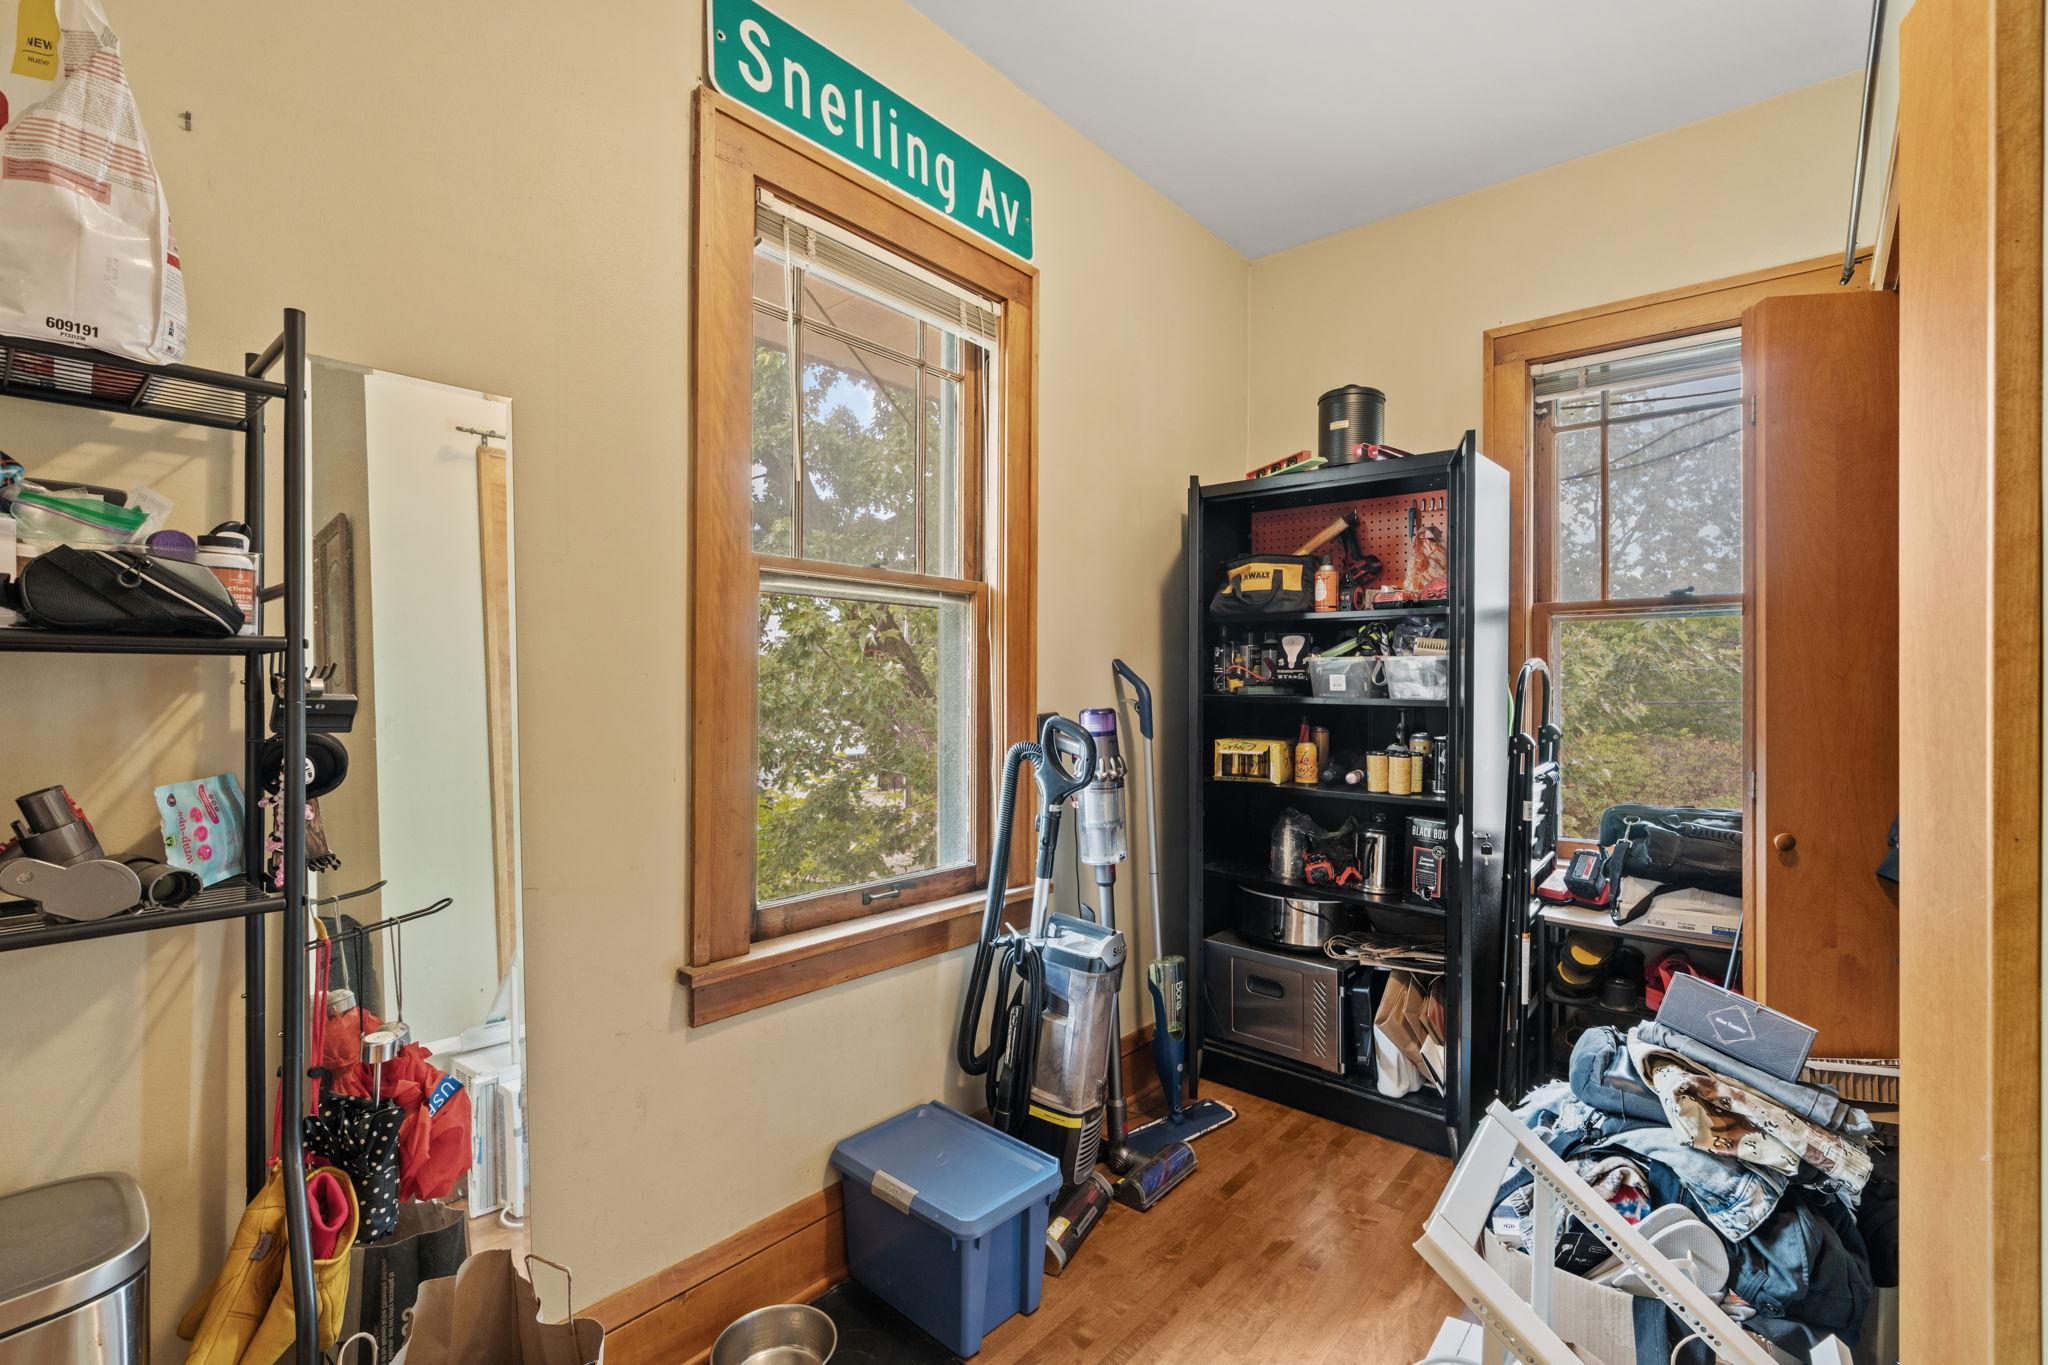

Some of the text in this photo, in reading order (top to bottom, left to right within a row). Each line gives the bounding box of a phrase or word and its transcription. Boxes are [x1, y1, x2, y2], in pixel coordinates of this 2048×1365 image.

[26, 37, 54, 50] NEW
[738, 19, 1020, 237] Snelling Av
[46, 316, 98, 338] 609191
[1243, 571, 1270, 581] WALT
[1412, 825, 1446, 841] BLACK BOX
[1175, 981, 1183, 1010] Bona
